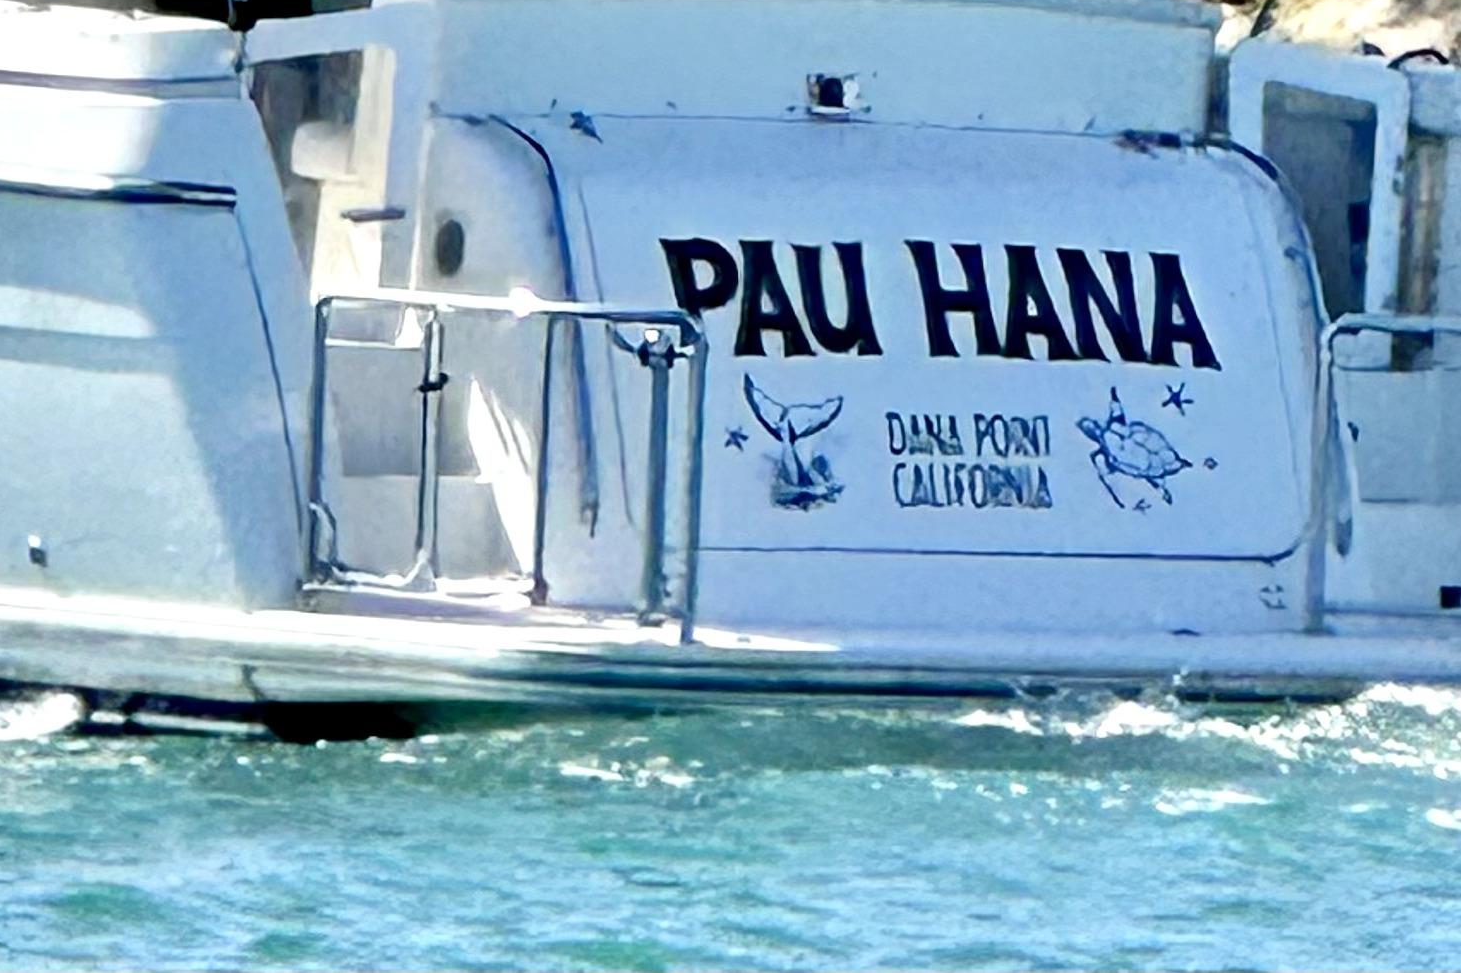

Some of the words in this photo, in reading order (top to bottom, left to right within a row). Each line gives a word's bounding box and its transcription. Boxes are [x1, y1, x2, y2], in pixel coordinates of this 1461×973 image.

[659, 237, 884, 358] PAU
[904, 239, 1222, 372] HANA
[885, 411, 964, 456] DANA
[893, 462, 1053, 510] CALIFORNIA
